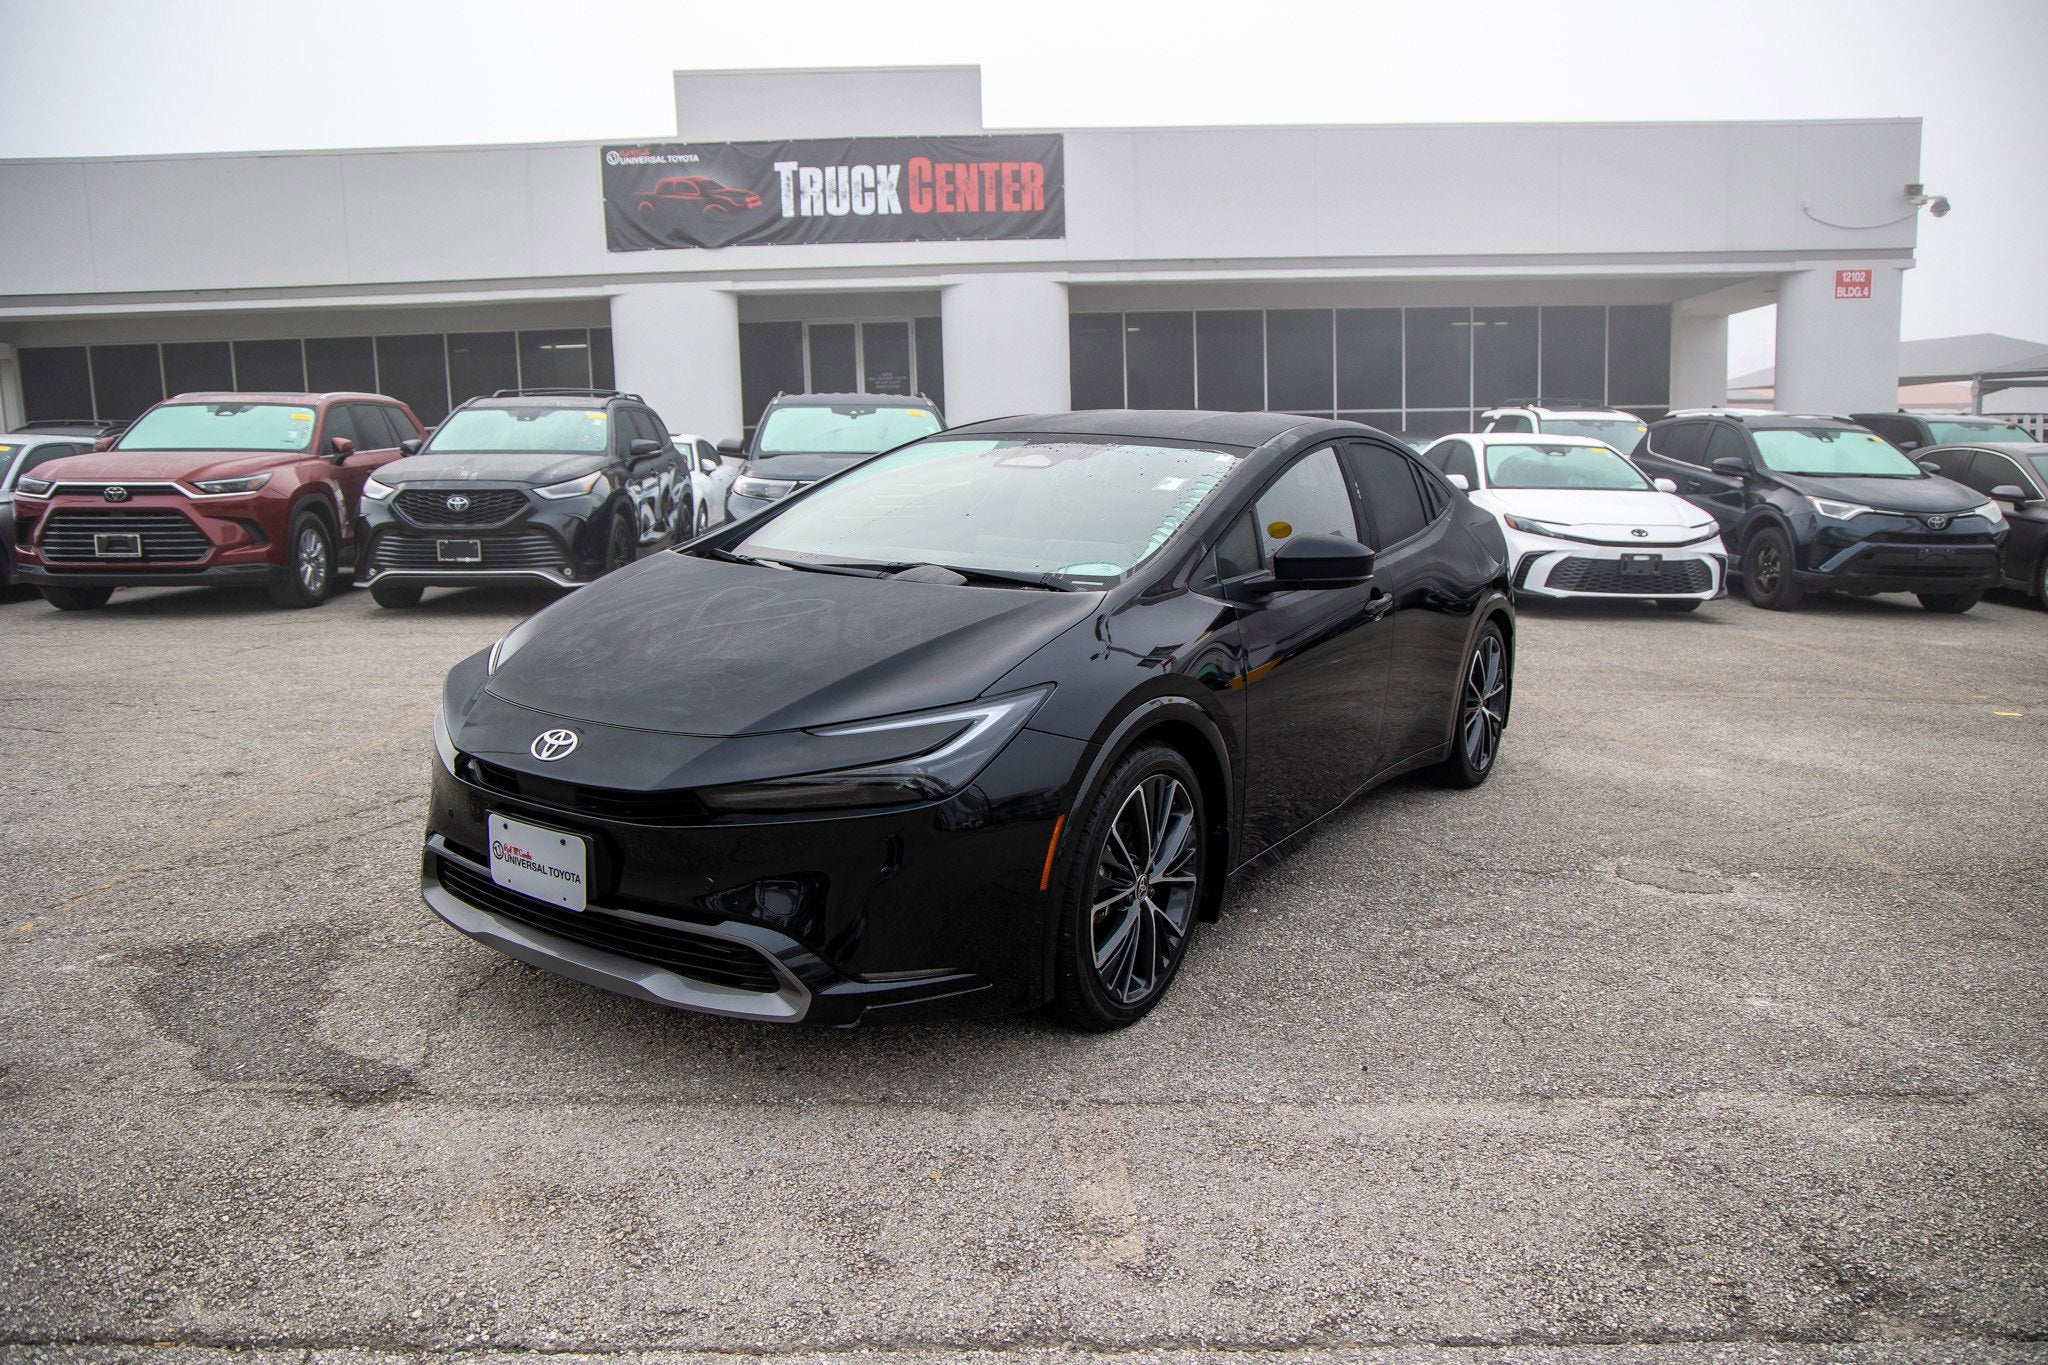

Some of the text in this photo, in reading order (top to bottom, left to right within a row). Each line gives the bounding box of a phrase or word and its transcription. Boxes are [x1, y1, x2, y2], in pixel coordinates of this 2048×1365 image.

[620, 154, 700, 165] UNIVERSAL TOYOTA
[774, 157, 1045, 218] TRUCK CENTER
[1842, 271, 1866, 282] 12102
[1863, 286, 1869, 297] 4
[504, 853, 581, 884] UNIVERSAL TOYOTA
